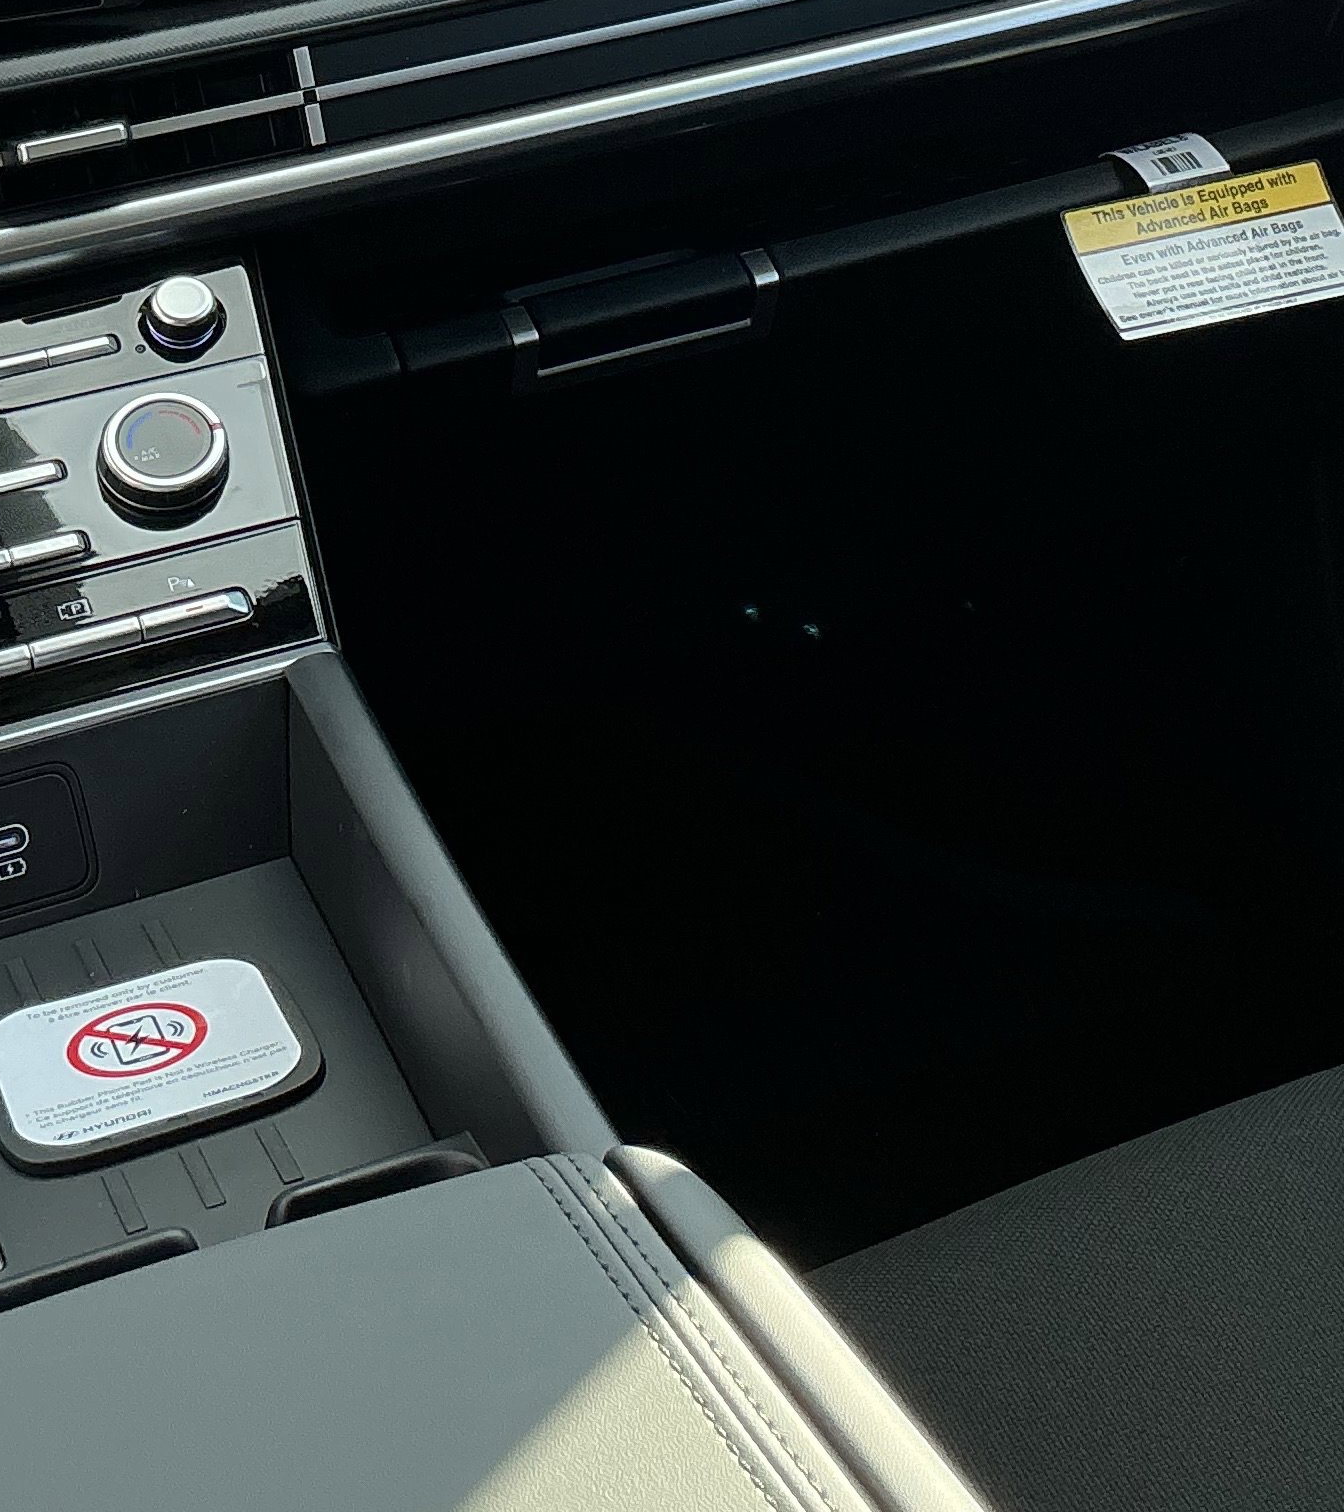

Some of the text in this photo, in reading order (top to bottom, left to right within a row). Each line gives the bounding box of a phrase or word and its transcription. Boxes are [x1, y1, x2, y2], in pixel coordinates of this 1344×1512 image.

[1091, 205, 1125, 225] This
[1127, 193, 1179, 217] Vehicle
[1197, 177, 1265, 205] Equipped
[1266, 170, 1297, 188] with
[1136, 195, 1270, 234] Advanced Air Bags
[1121, 248, 1155, 266] Even
[1156, 242, 1184, 258] with
[1186, 229, 1248, 251] Advanced
[1270, 217, 1304, 236] Bags
[82, 1107, 152, 1133] HYUNDAI
